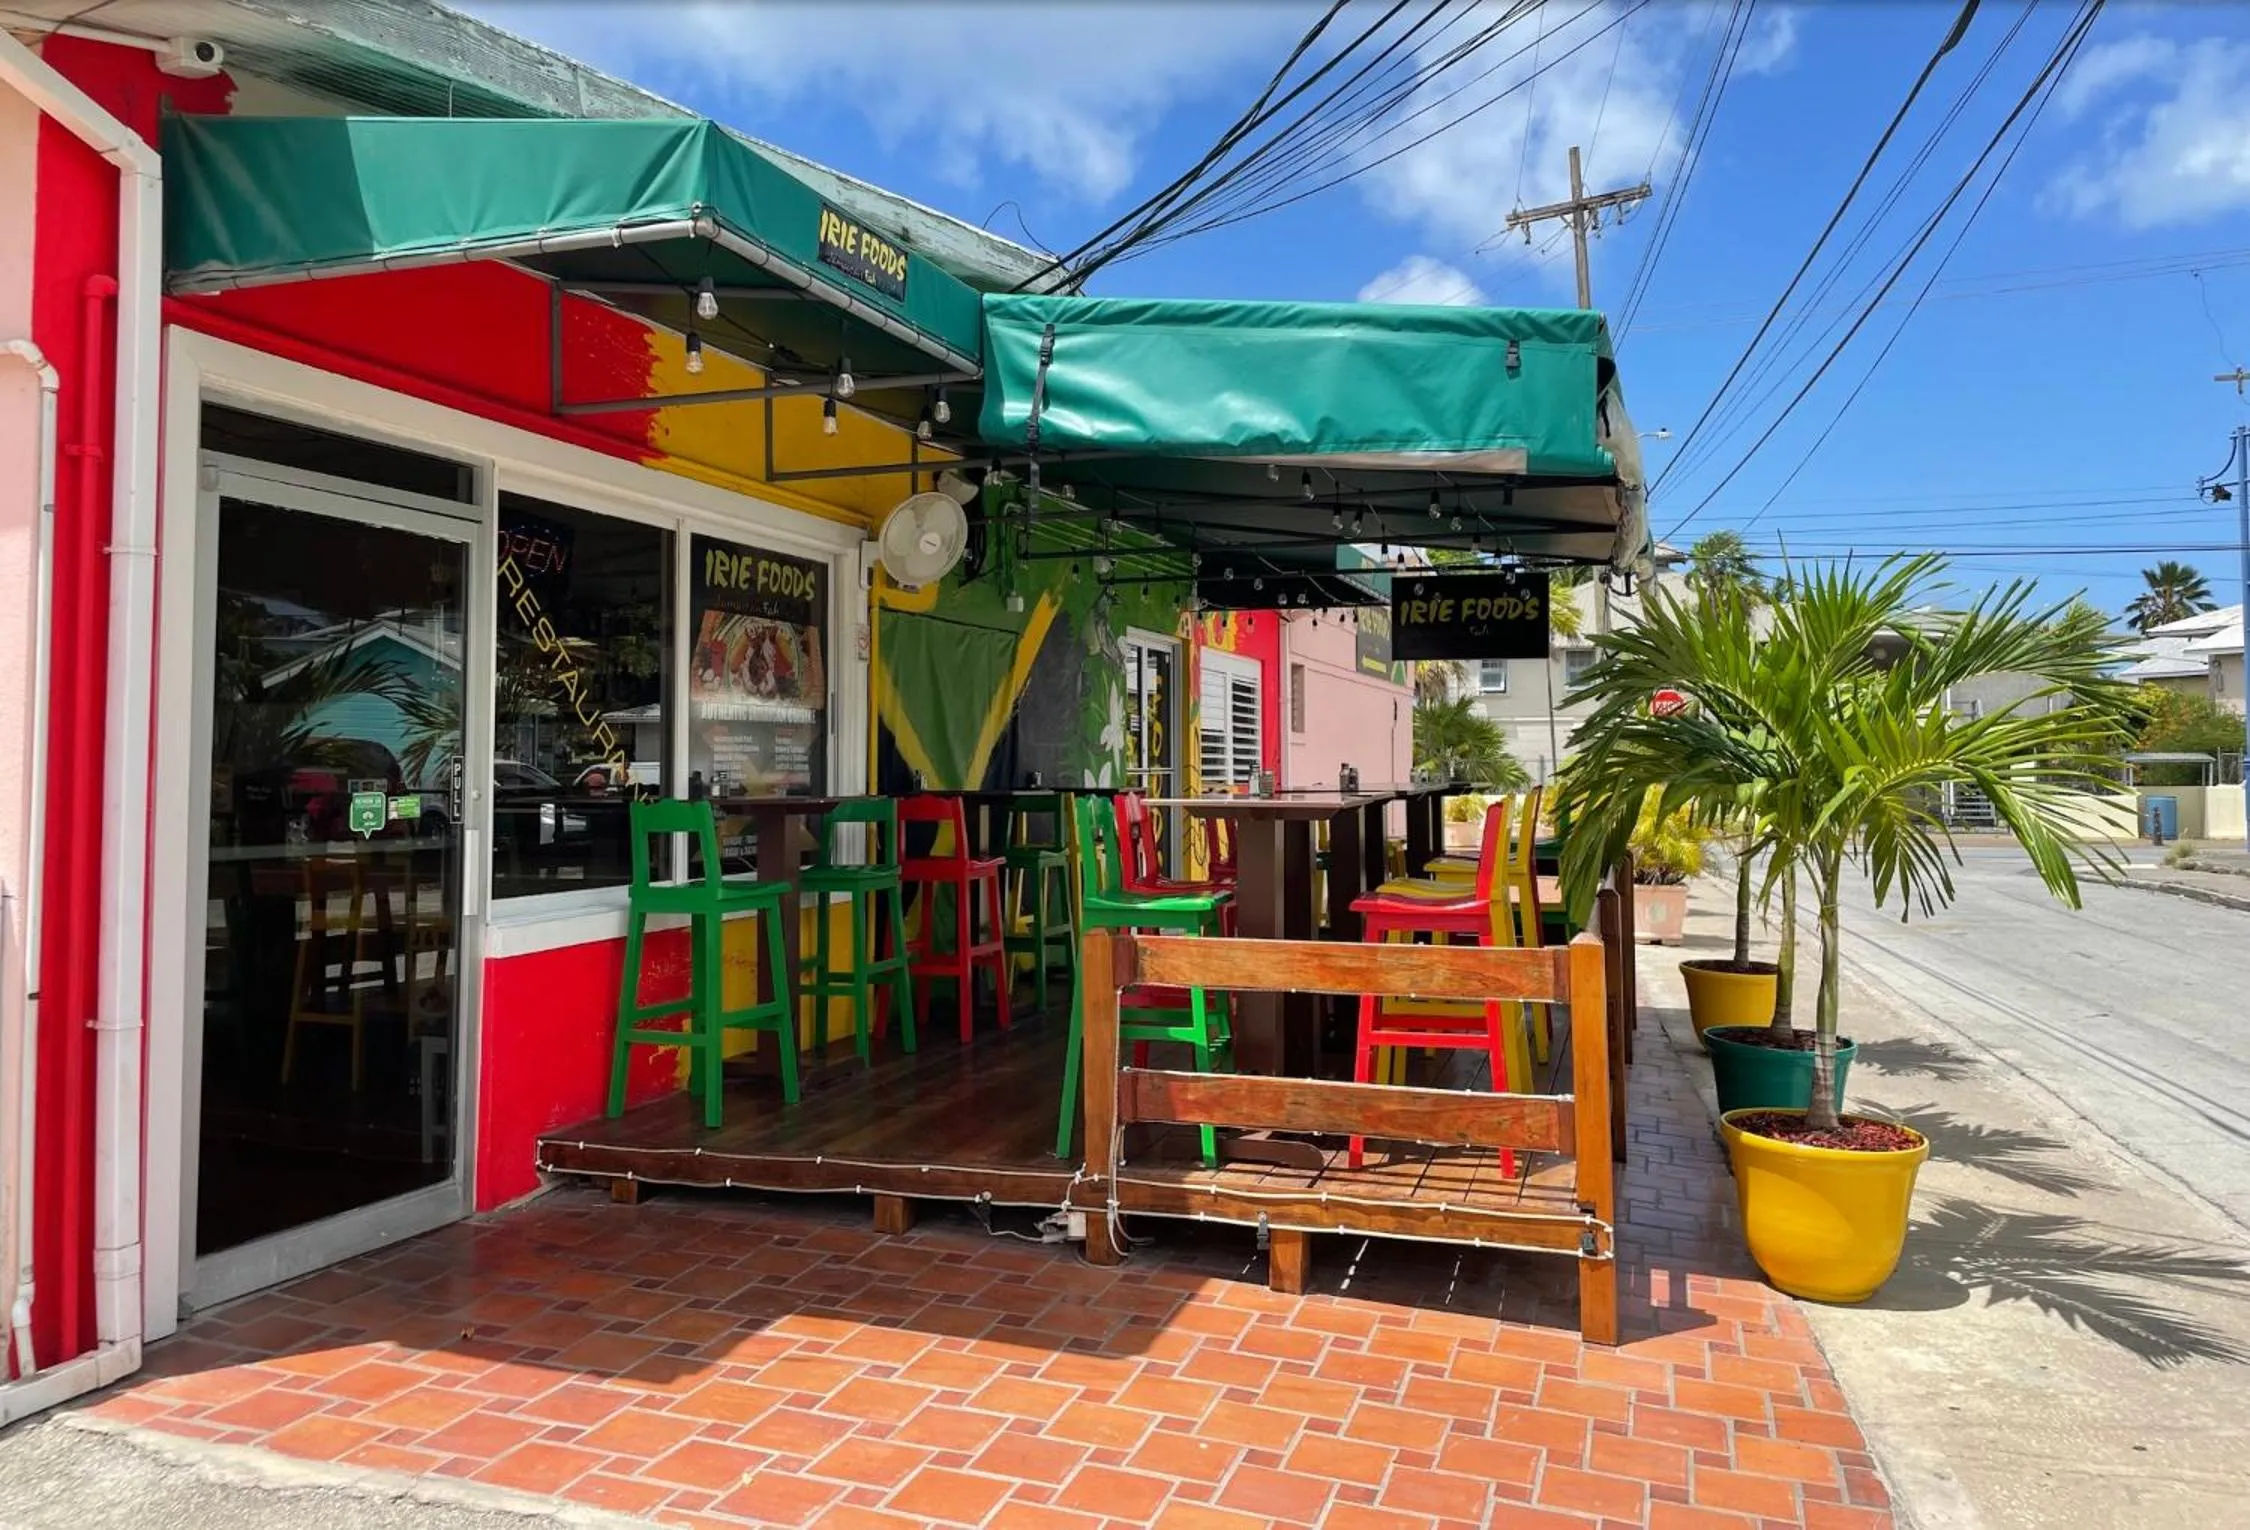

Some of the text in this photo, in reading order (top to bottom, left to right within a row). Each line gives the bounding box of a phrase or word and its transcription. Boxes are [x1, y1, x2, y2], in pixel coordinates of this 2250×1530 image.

[820, 209, 858, 254] IRIE
[861, 232, 907, 282] FOODS
[705, 549, 816, 601] IRIE FOODS
[1400, 599, 1454, 627] IRIE
[1461, 597, 1540, 622] FOODS
[498, 556, 651, 801] RESTAURAN
[452, 763, 462, 817] PULL
